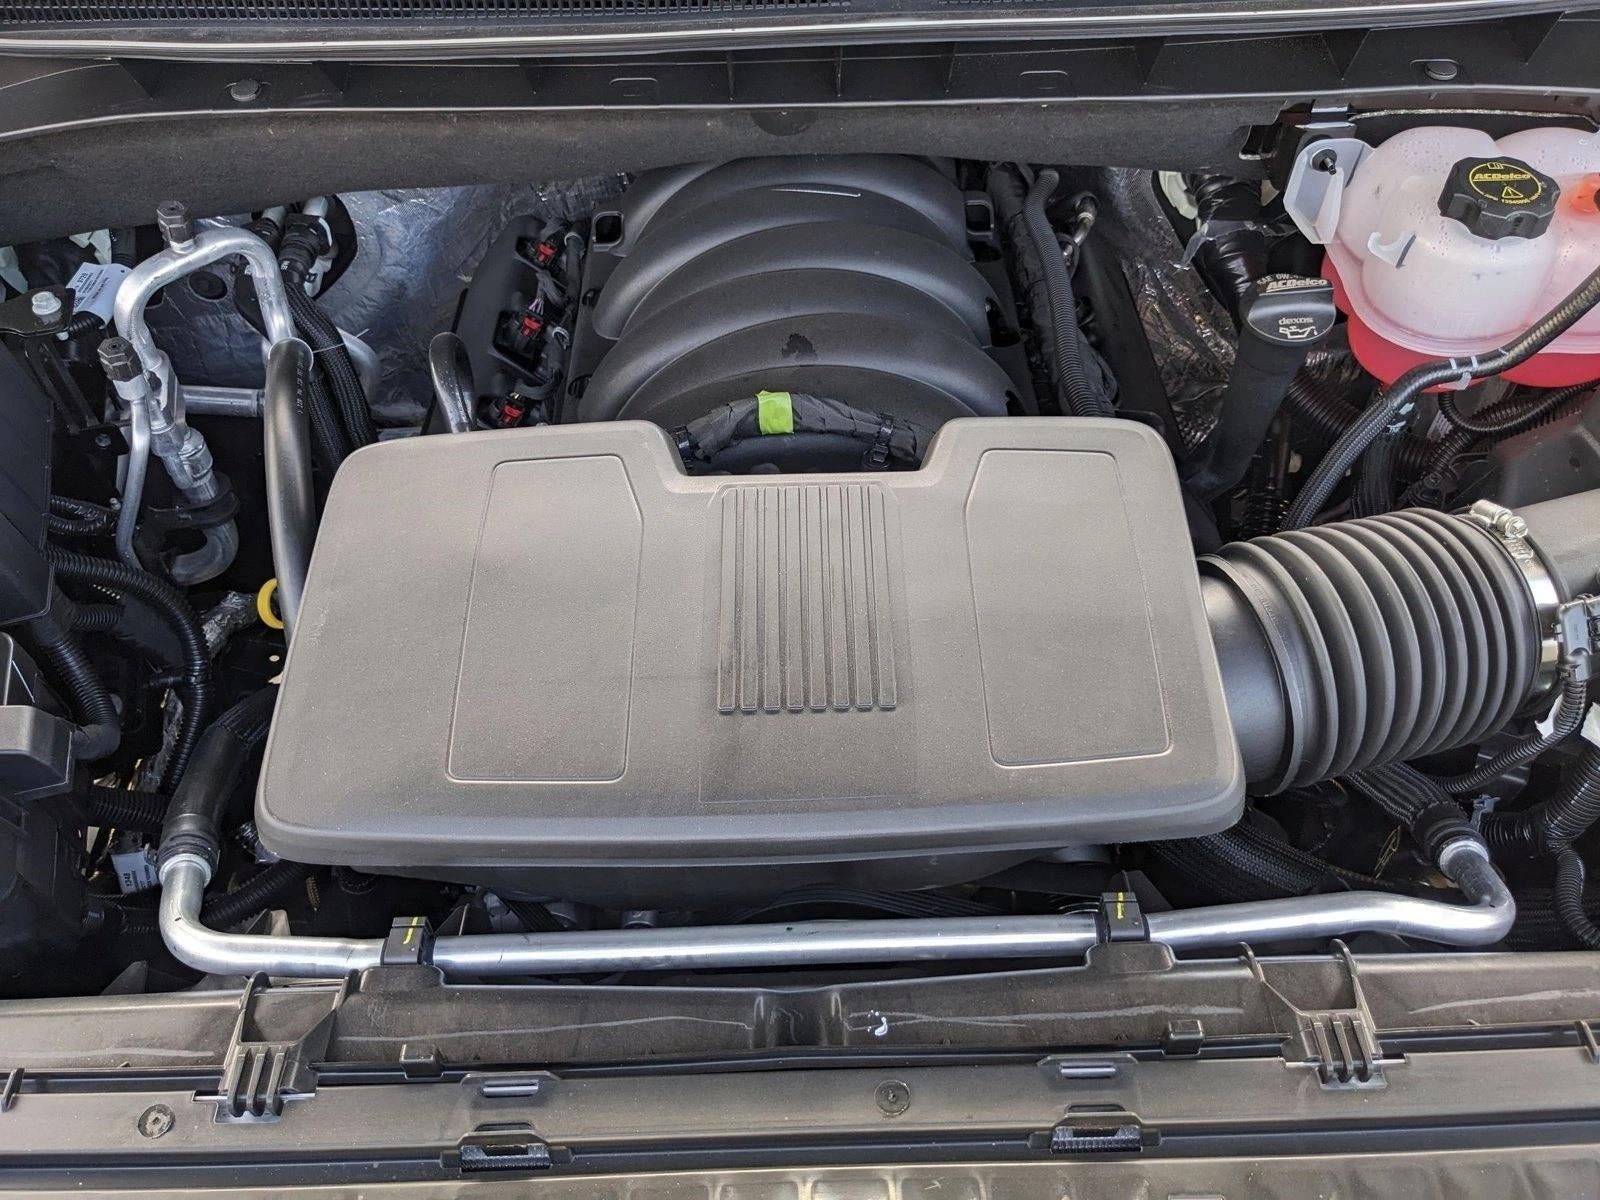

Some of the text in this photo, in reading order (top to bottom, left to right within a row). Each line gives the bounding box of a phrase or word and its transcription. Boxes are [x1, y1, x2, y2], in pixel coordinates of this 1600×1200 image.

[1472, 173, 1531, 181] ACDelco
[1266, 278, 1328, 292] ACDelco
[1279, 317, 1313, 325] dexos
